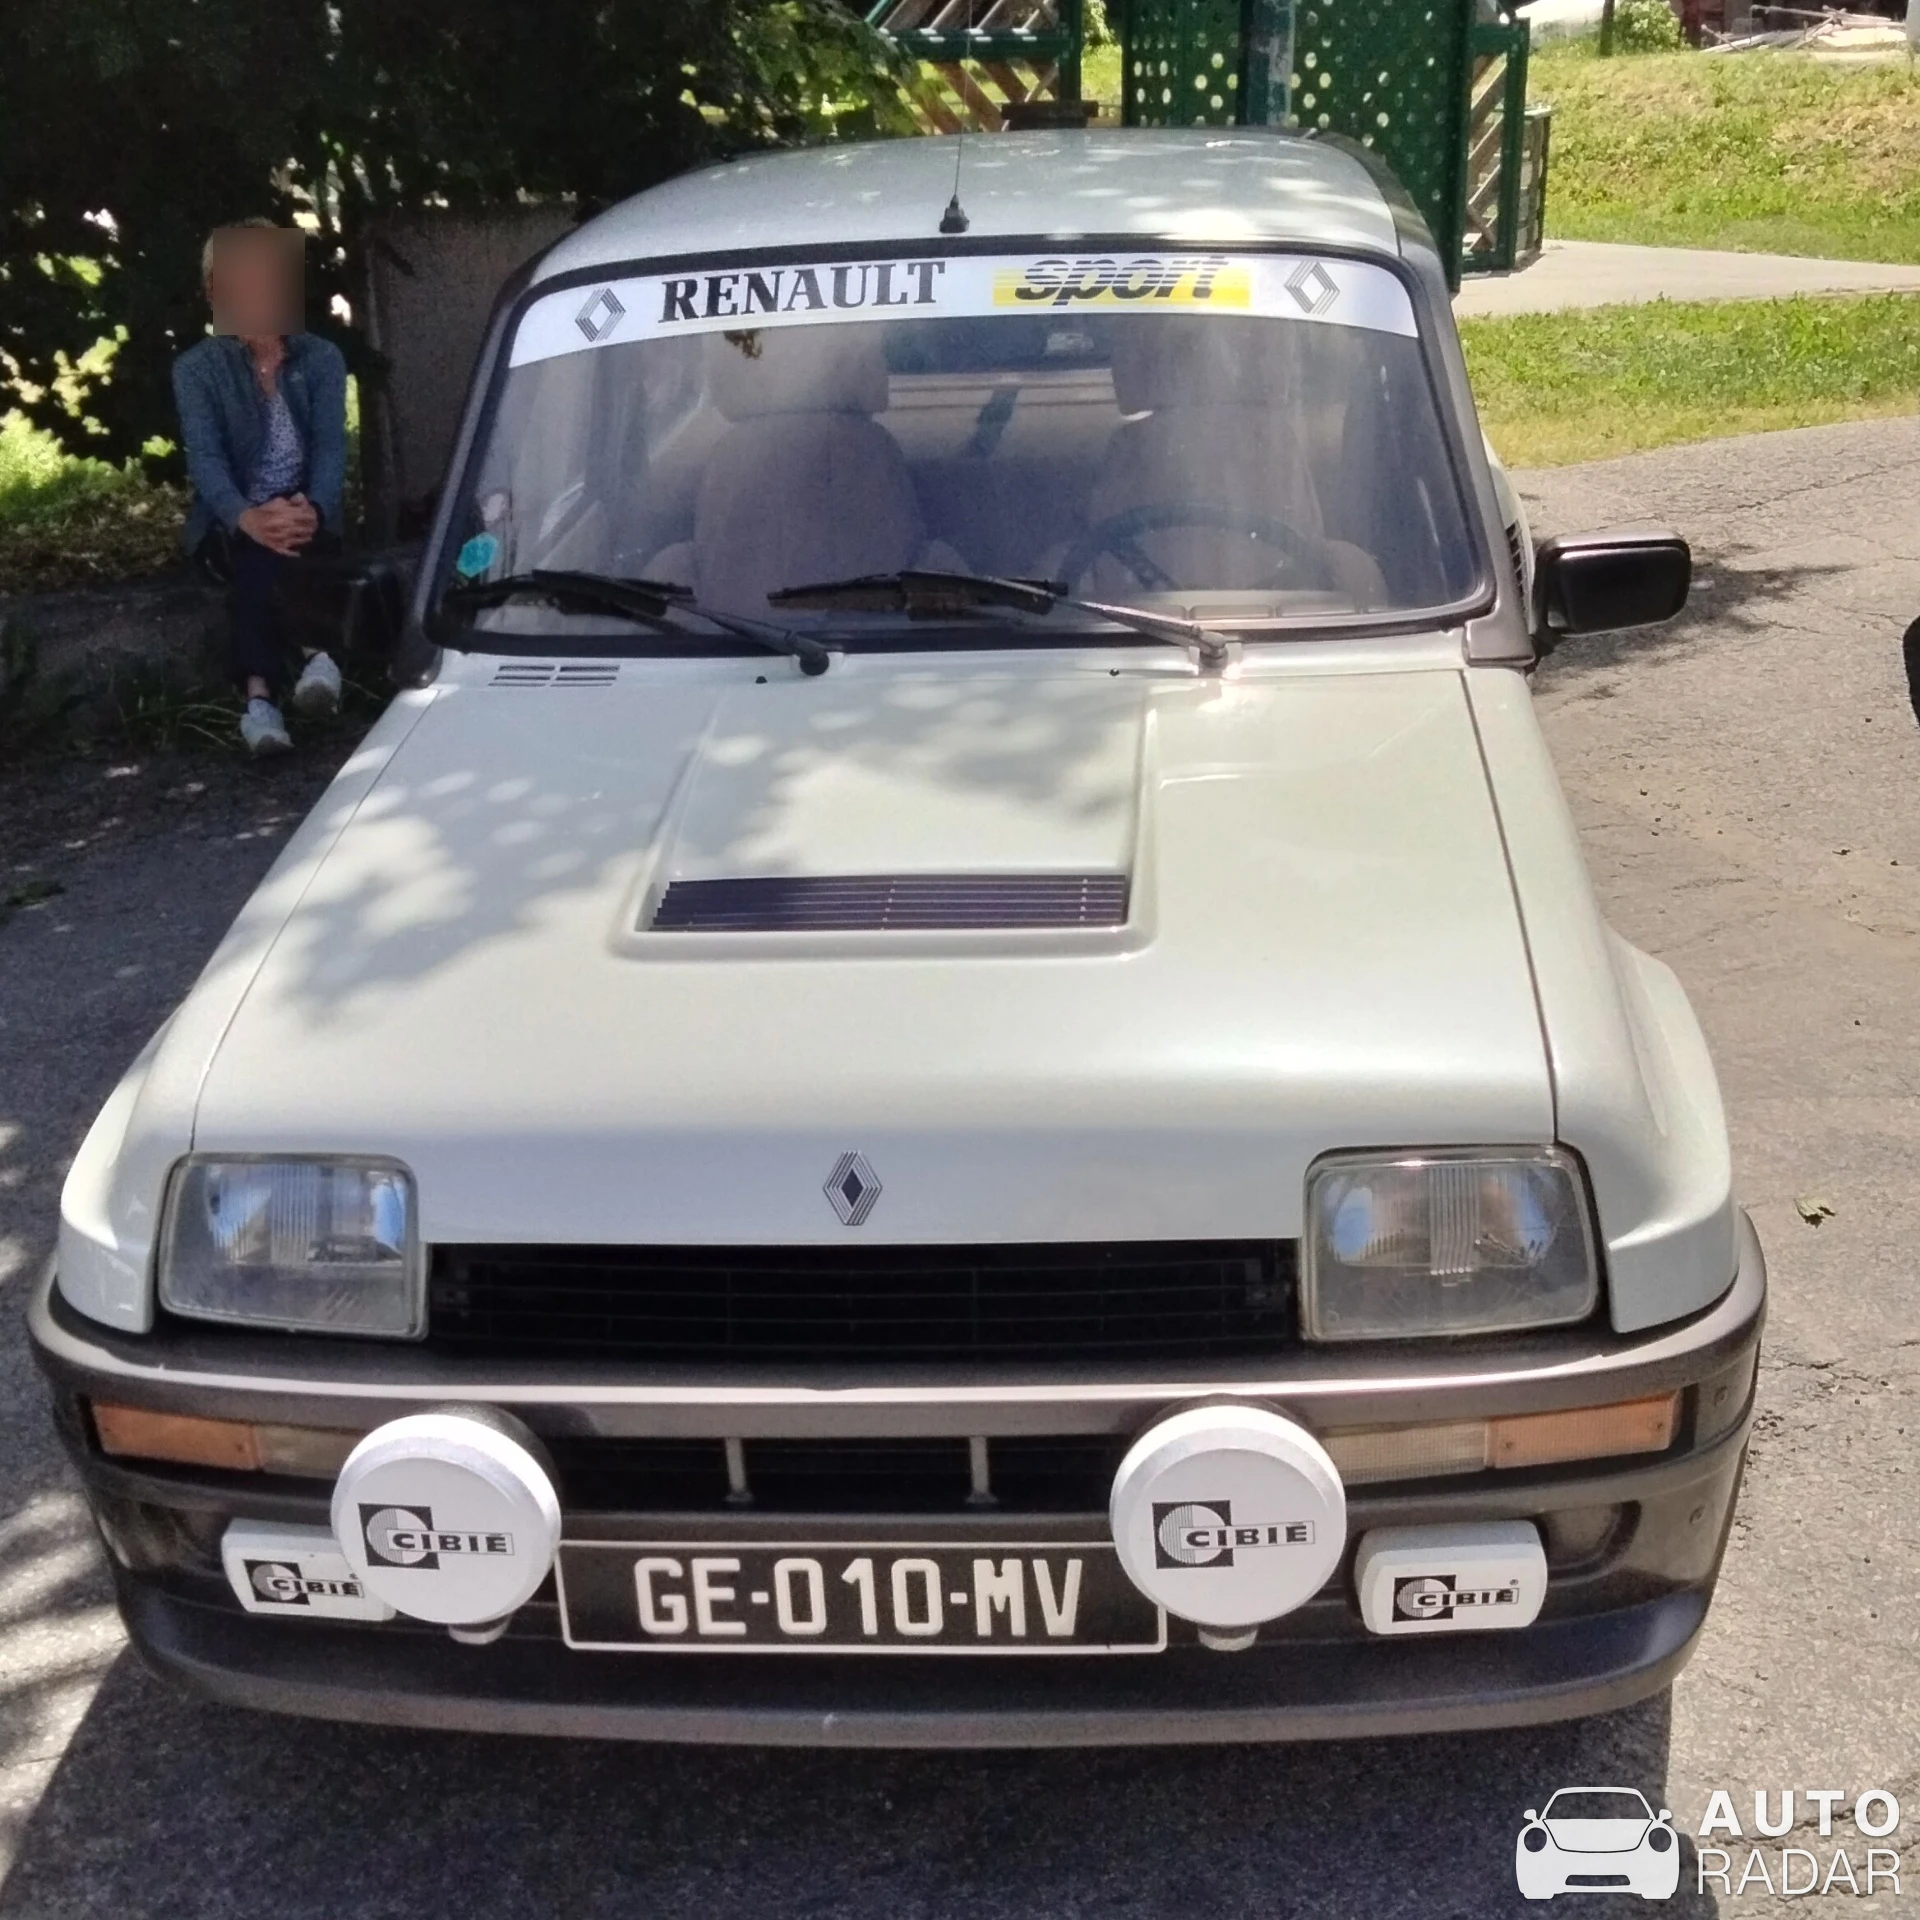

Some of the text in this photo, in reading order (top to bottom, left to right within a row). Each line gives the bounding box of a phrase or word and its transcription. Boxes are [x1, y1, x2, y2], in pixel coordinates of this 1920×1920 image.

[657, 256, 1229, 323] RENAULT sport
[633, 1557, 1083, 1636] GE-010-MV
